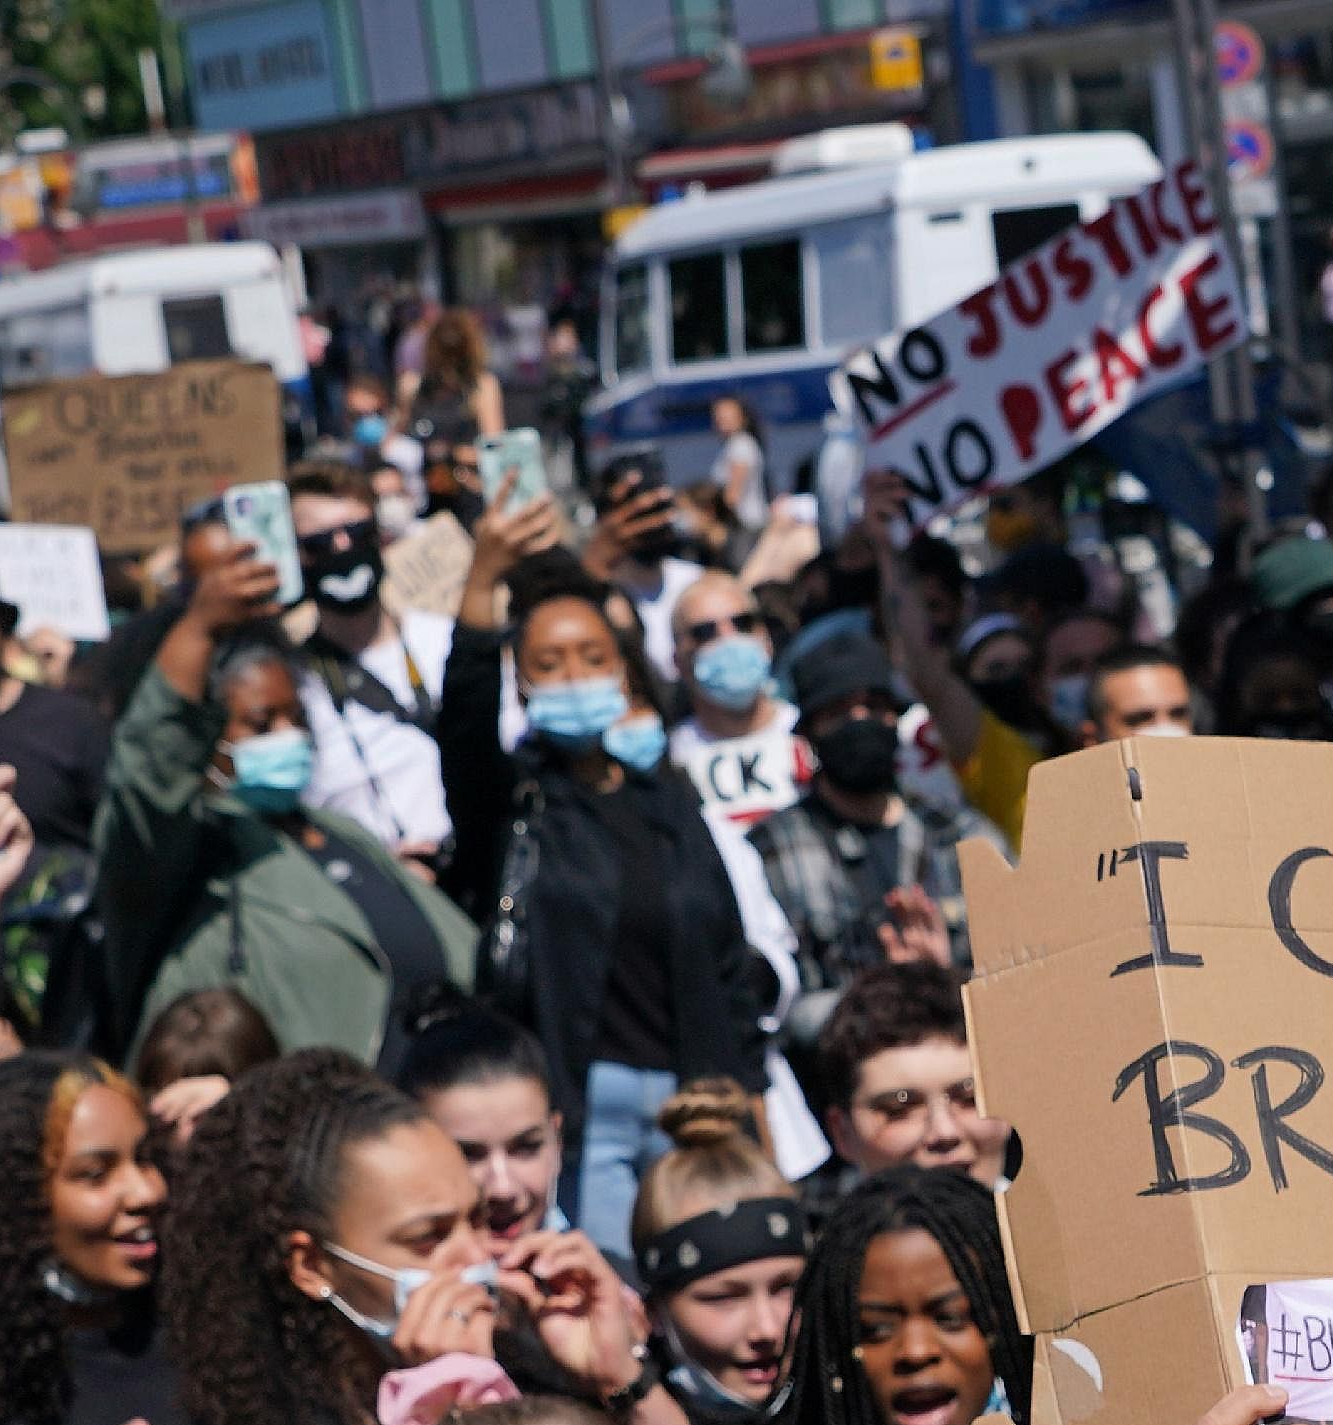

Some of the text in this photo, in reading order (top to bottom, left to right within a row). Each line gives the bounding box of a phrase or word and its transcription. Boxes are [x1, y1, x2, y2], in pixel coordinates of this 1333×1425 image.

[847, 159, 1220, 426] NO JUSTICE
[889, 252, 1238, 524] NO PEACE
